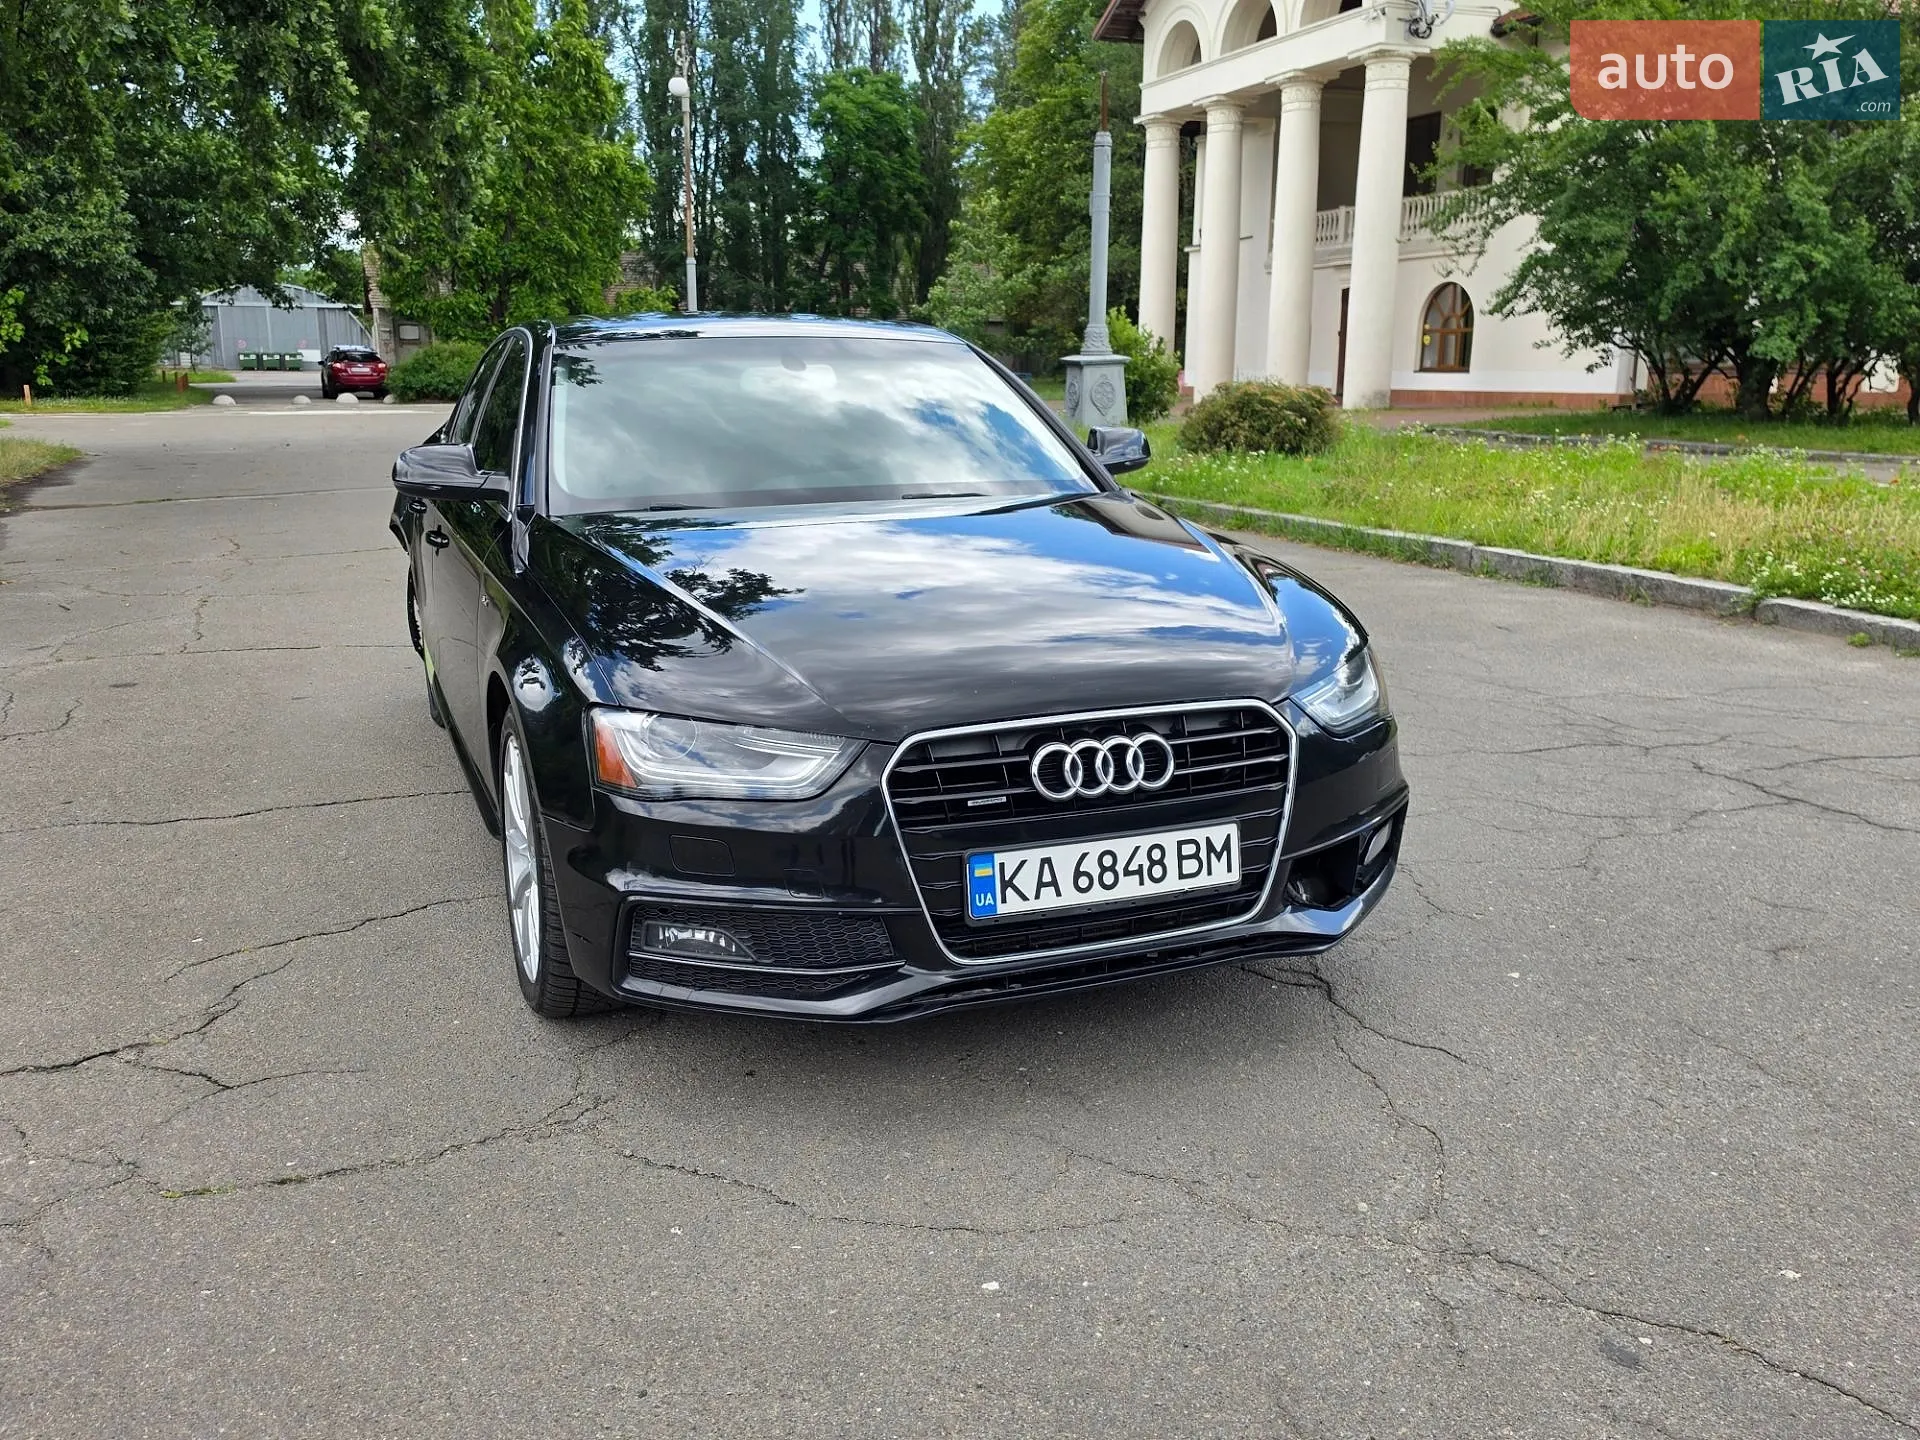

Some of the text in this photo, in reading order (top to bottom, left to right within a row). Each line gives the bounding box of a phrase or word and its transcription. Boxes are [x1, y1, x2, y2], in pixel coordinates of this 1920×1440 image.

[999, 833, 1233, 904] KA 6848 BM
[975, 892, 995, 907] UA
